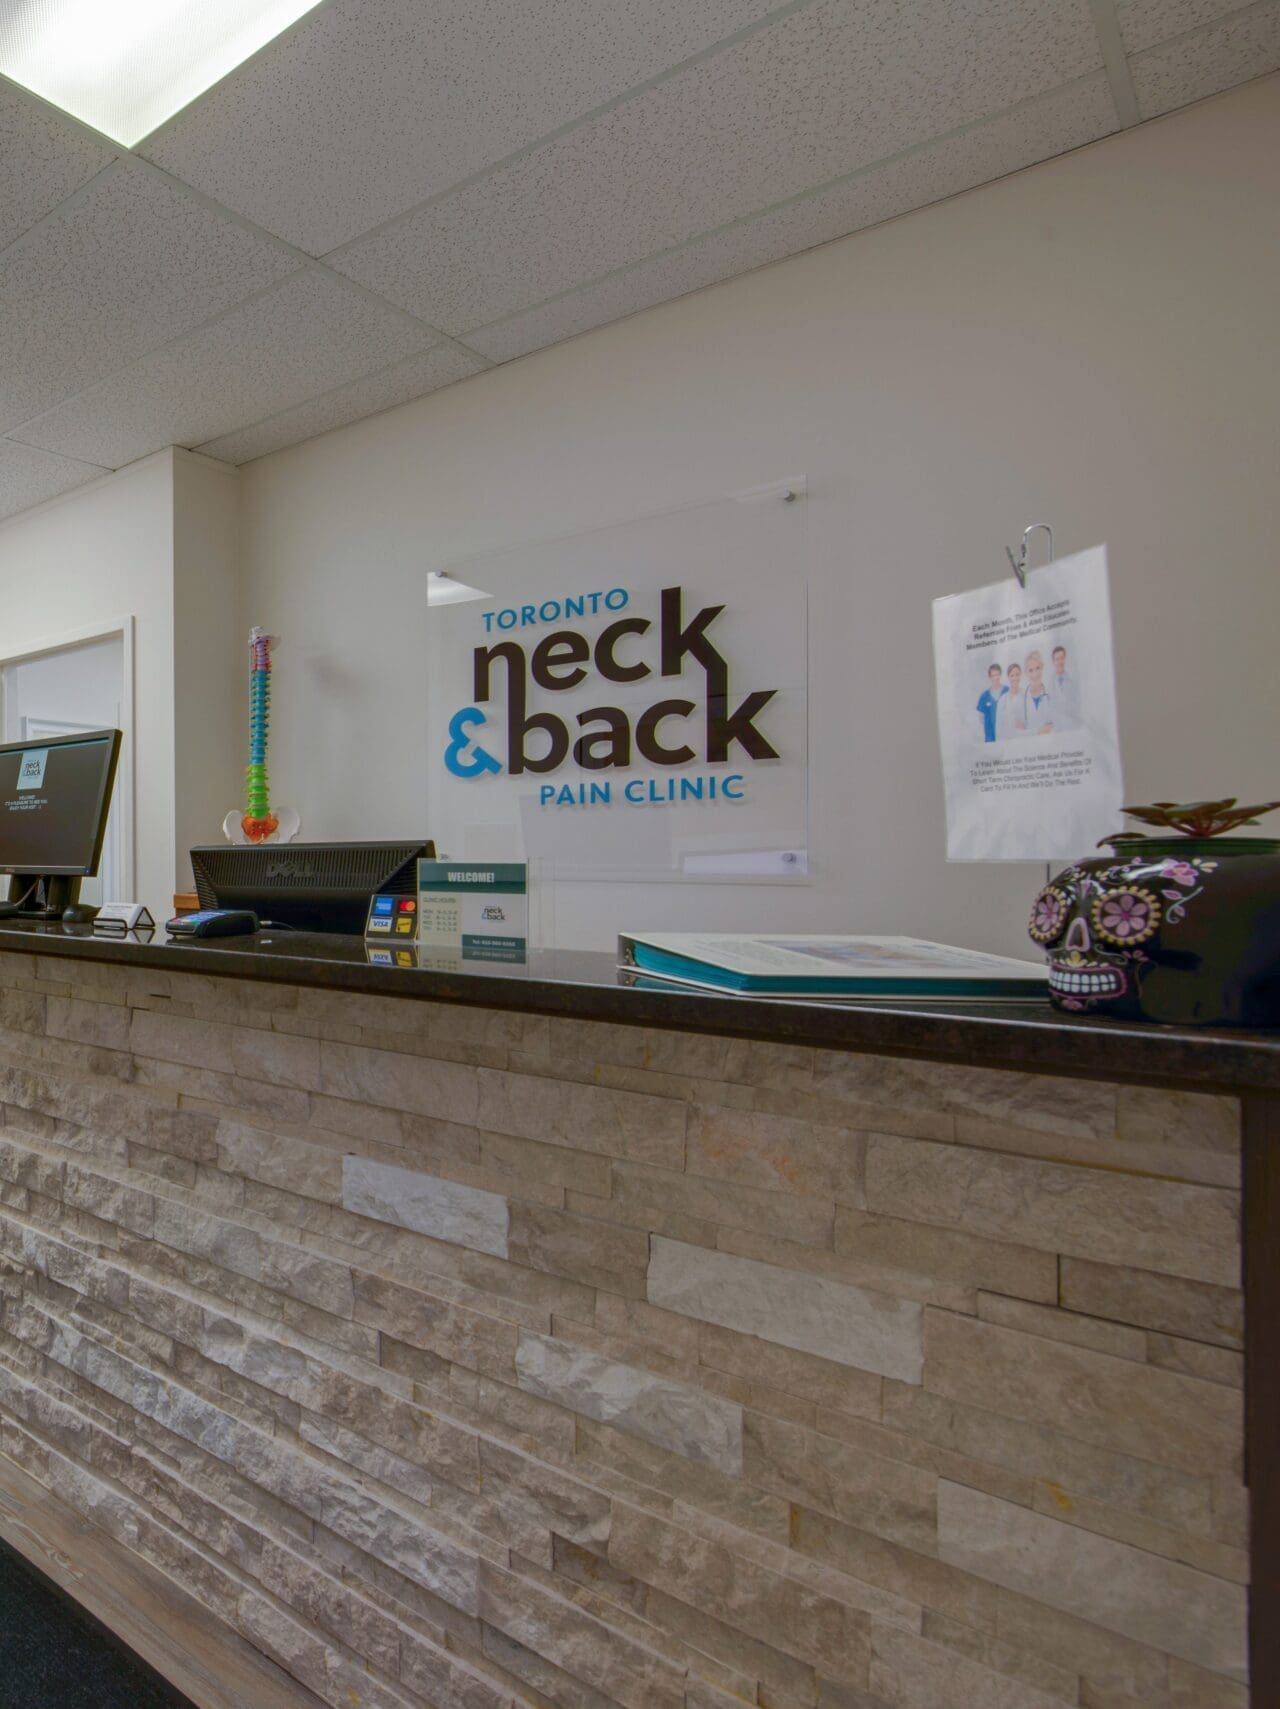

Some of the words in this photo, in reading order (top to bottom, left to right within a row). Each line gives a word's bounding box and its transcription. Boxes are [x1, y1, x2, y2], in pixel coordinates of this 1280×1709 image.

[482, 588, 629, 633] TORONTO
[474, 586, 728, 703] neck
[444, 706, 503, 779] &
[508, 672, 781, 775] back
[540, 782, 610, 806] PAIN
[625, 775, 744, 802] CLINIC
[447, 872, 495, 883] WELCOME!
[484, 906, 502, 914] neck
[487, 912, 505, 921] back
[373, 920, 389, 928] VISA
